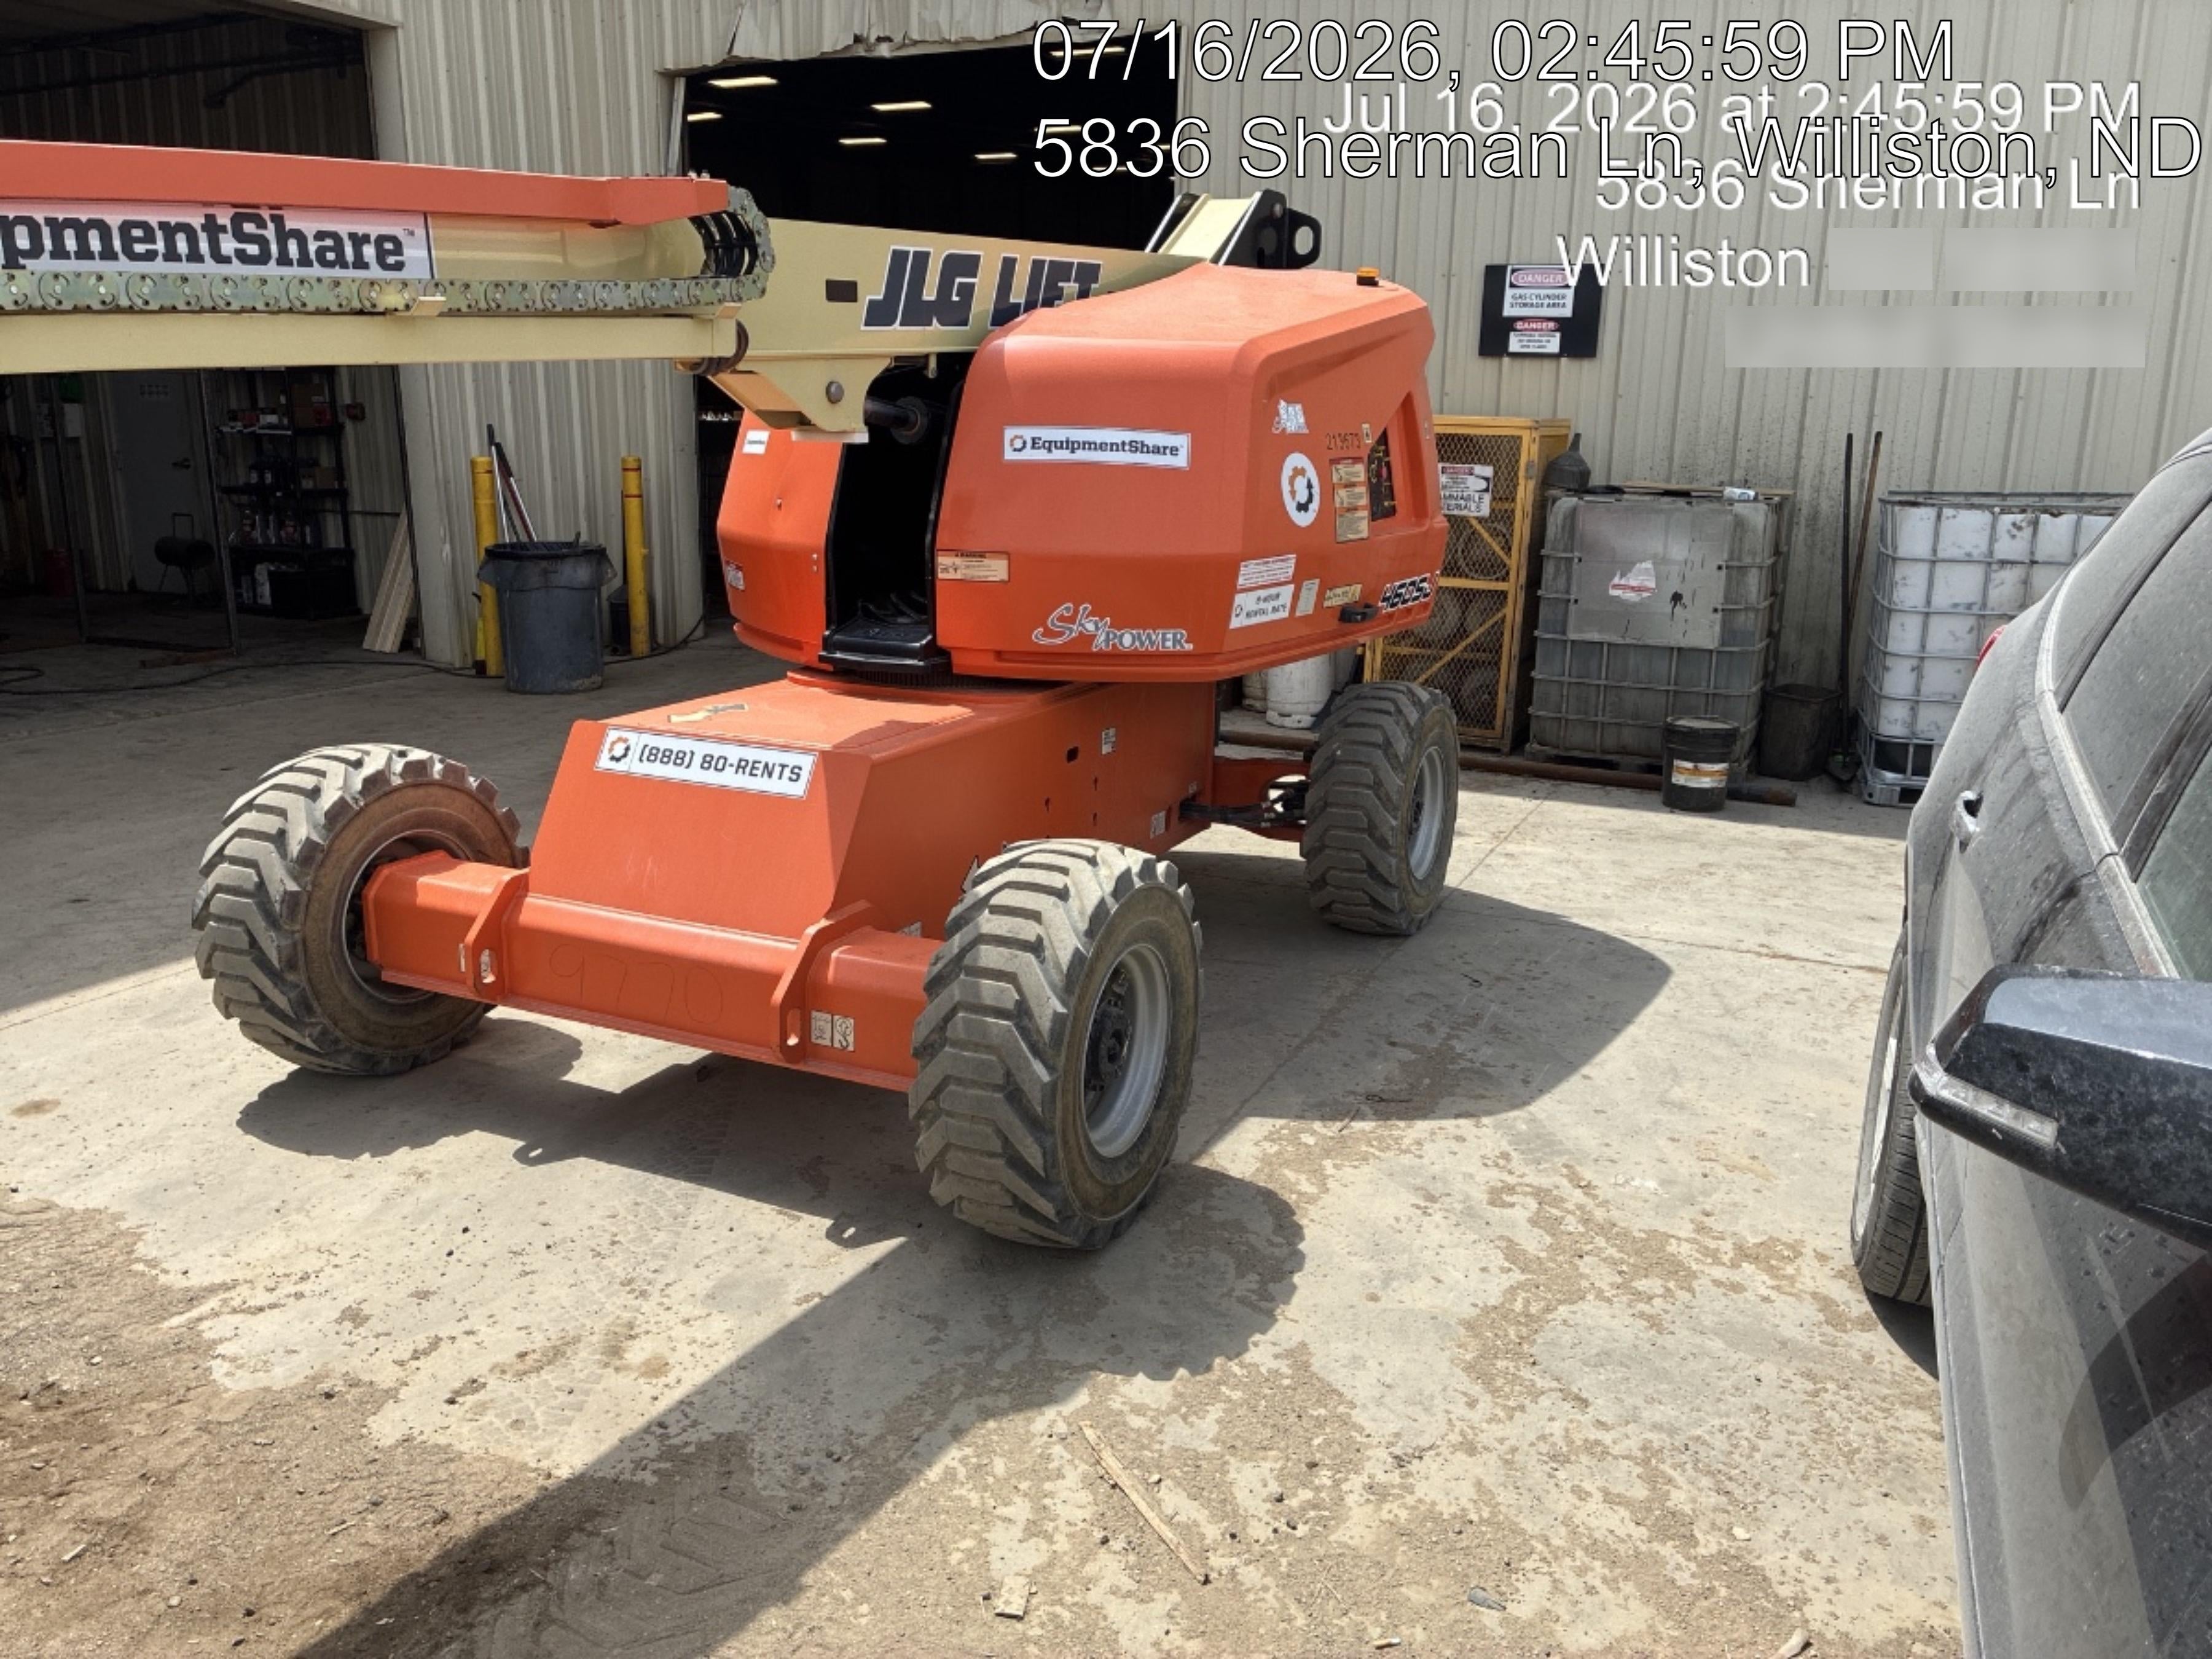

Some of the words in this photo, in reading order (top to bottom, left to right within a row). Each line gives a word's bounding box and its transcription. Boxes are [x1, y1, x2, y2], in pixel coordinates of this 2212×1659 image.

[861, 246, 983, 330] JLG
[988, 253, 1102, 329] LIFT
[1030, 436, 1180, 457] EquipmentShare
[638, 744, 695, 769] (888)
[699, 753, 803, 783] 80-RENTS
